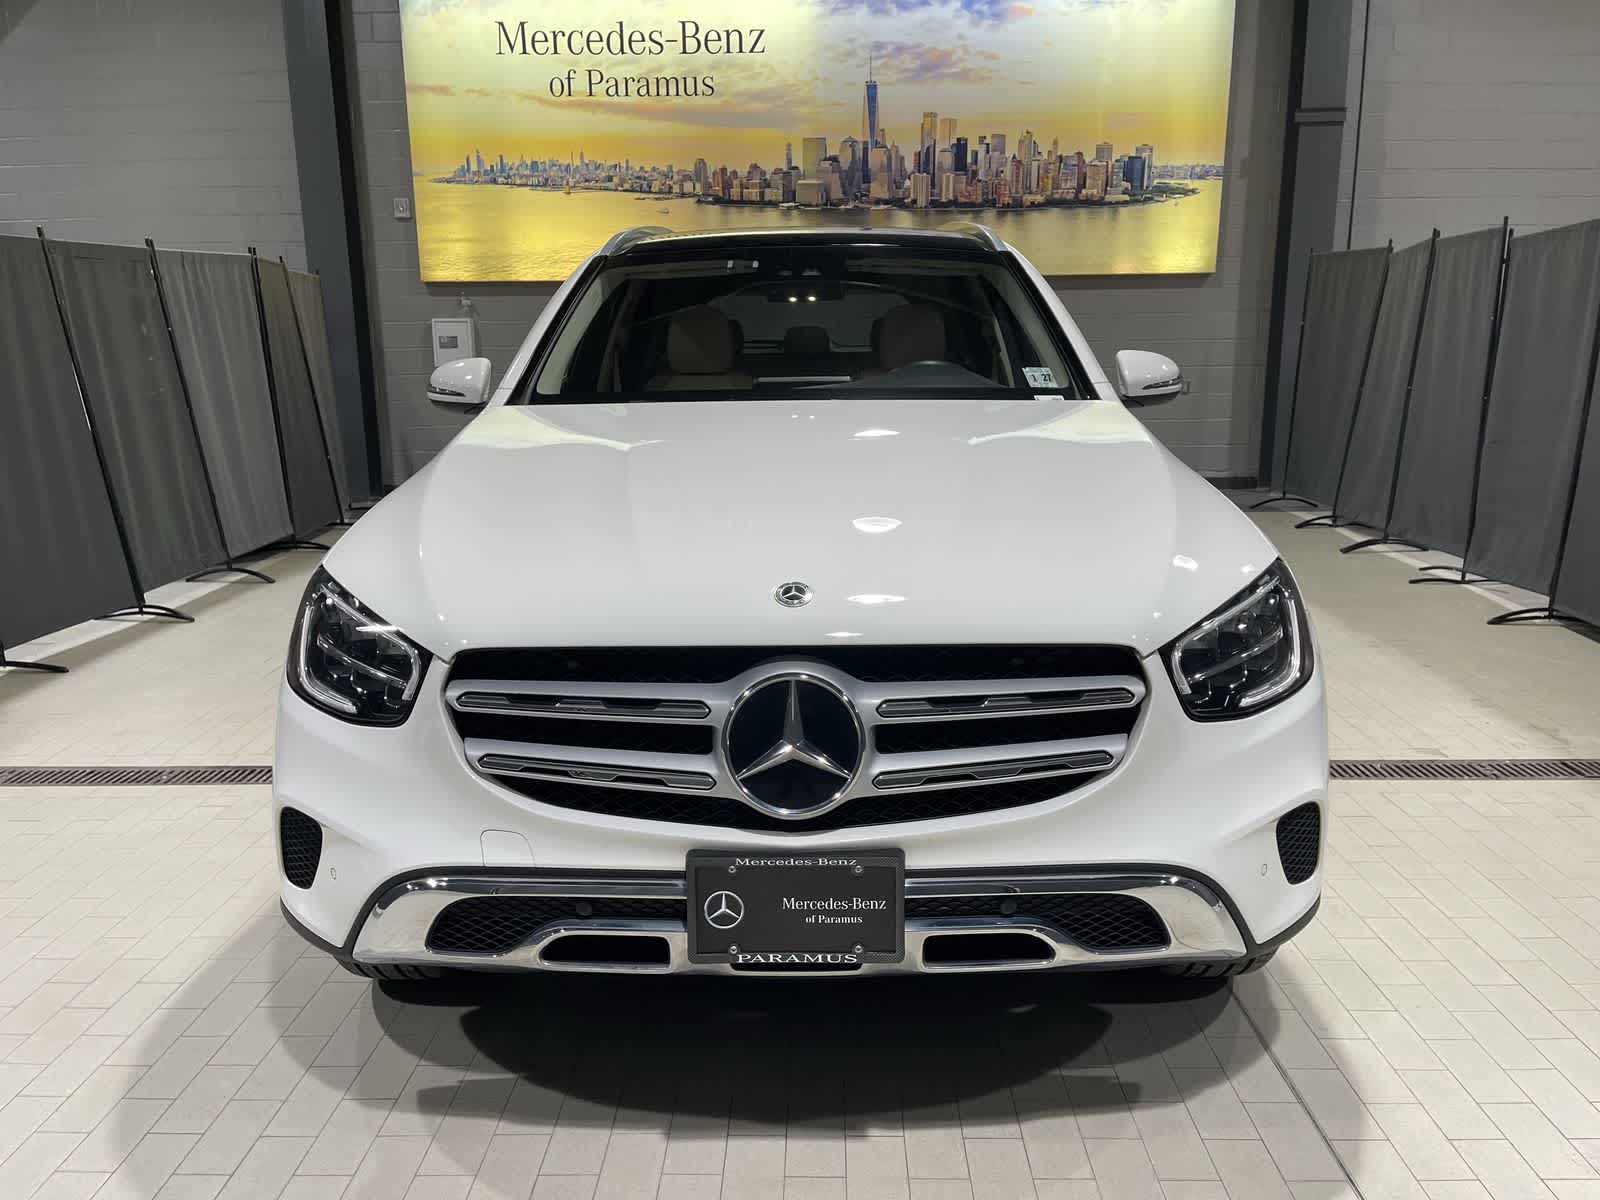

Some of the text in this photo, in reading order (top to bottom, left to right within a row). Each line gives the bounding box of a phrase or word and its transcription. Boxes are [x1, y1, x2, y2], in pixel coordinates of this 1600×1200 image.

[495, 20, 766, 55] Mercedes-Benz
[549, 69, 715, 97] of Paramus
[735, 857, 858, 866] Mercedes-Benz
[782, 897, 887, 910] Mercedes-Benz
[805, 914, 863, 924] of Paramus
[736, 954, 858, 964] PARAMUS
